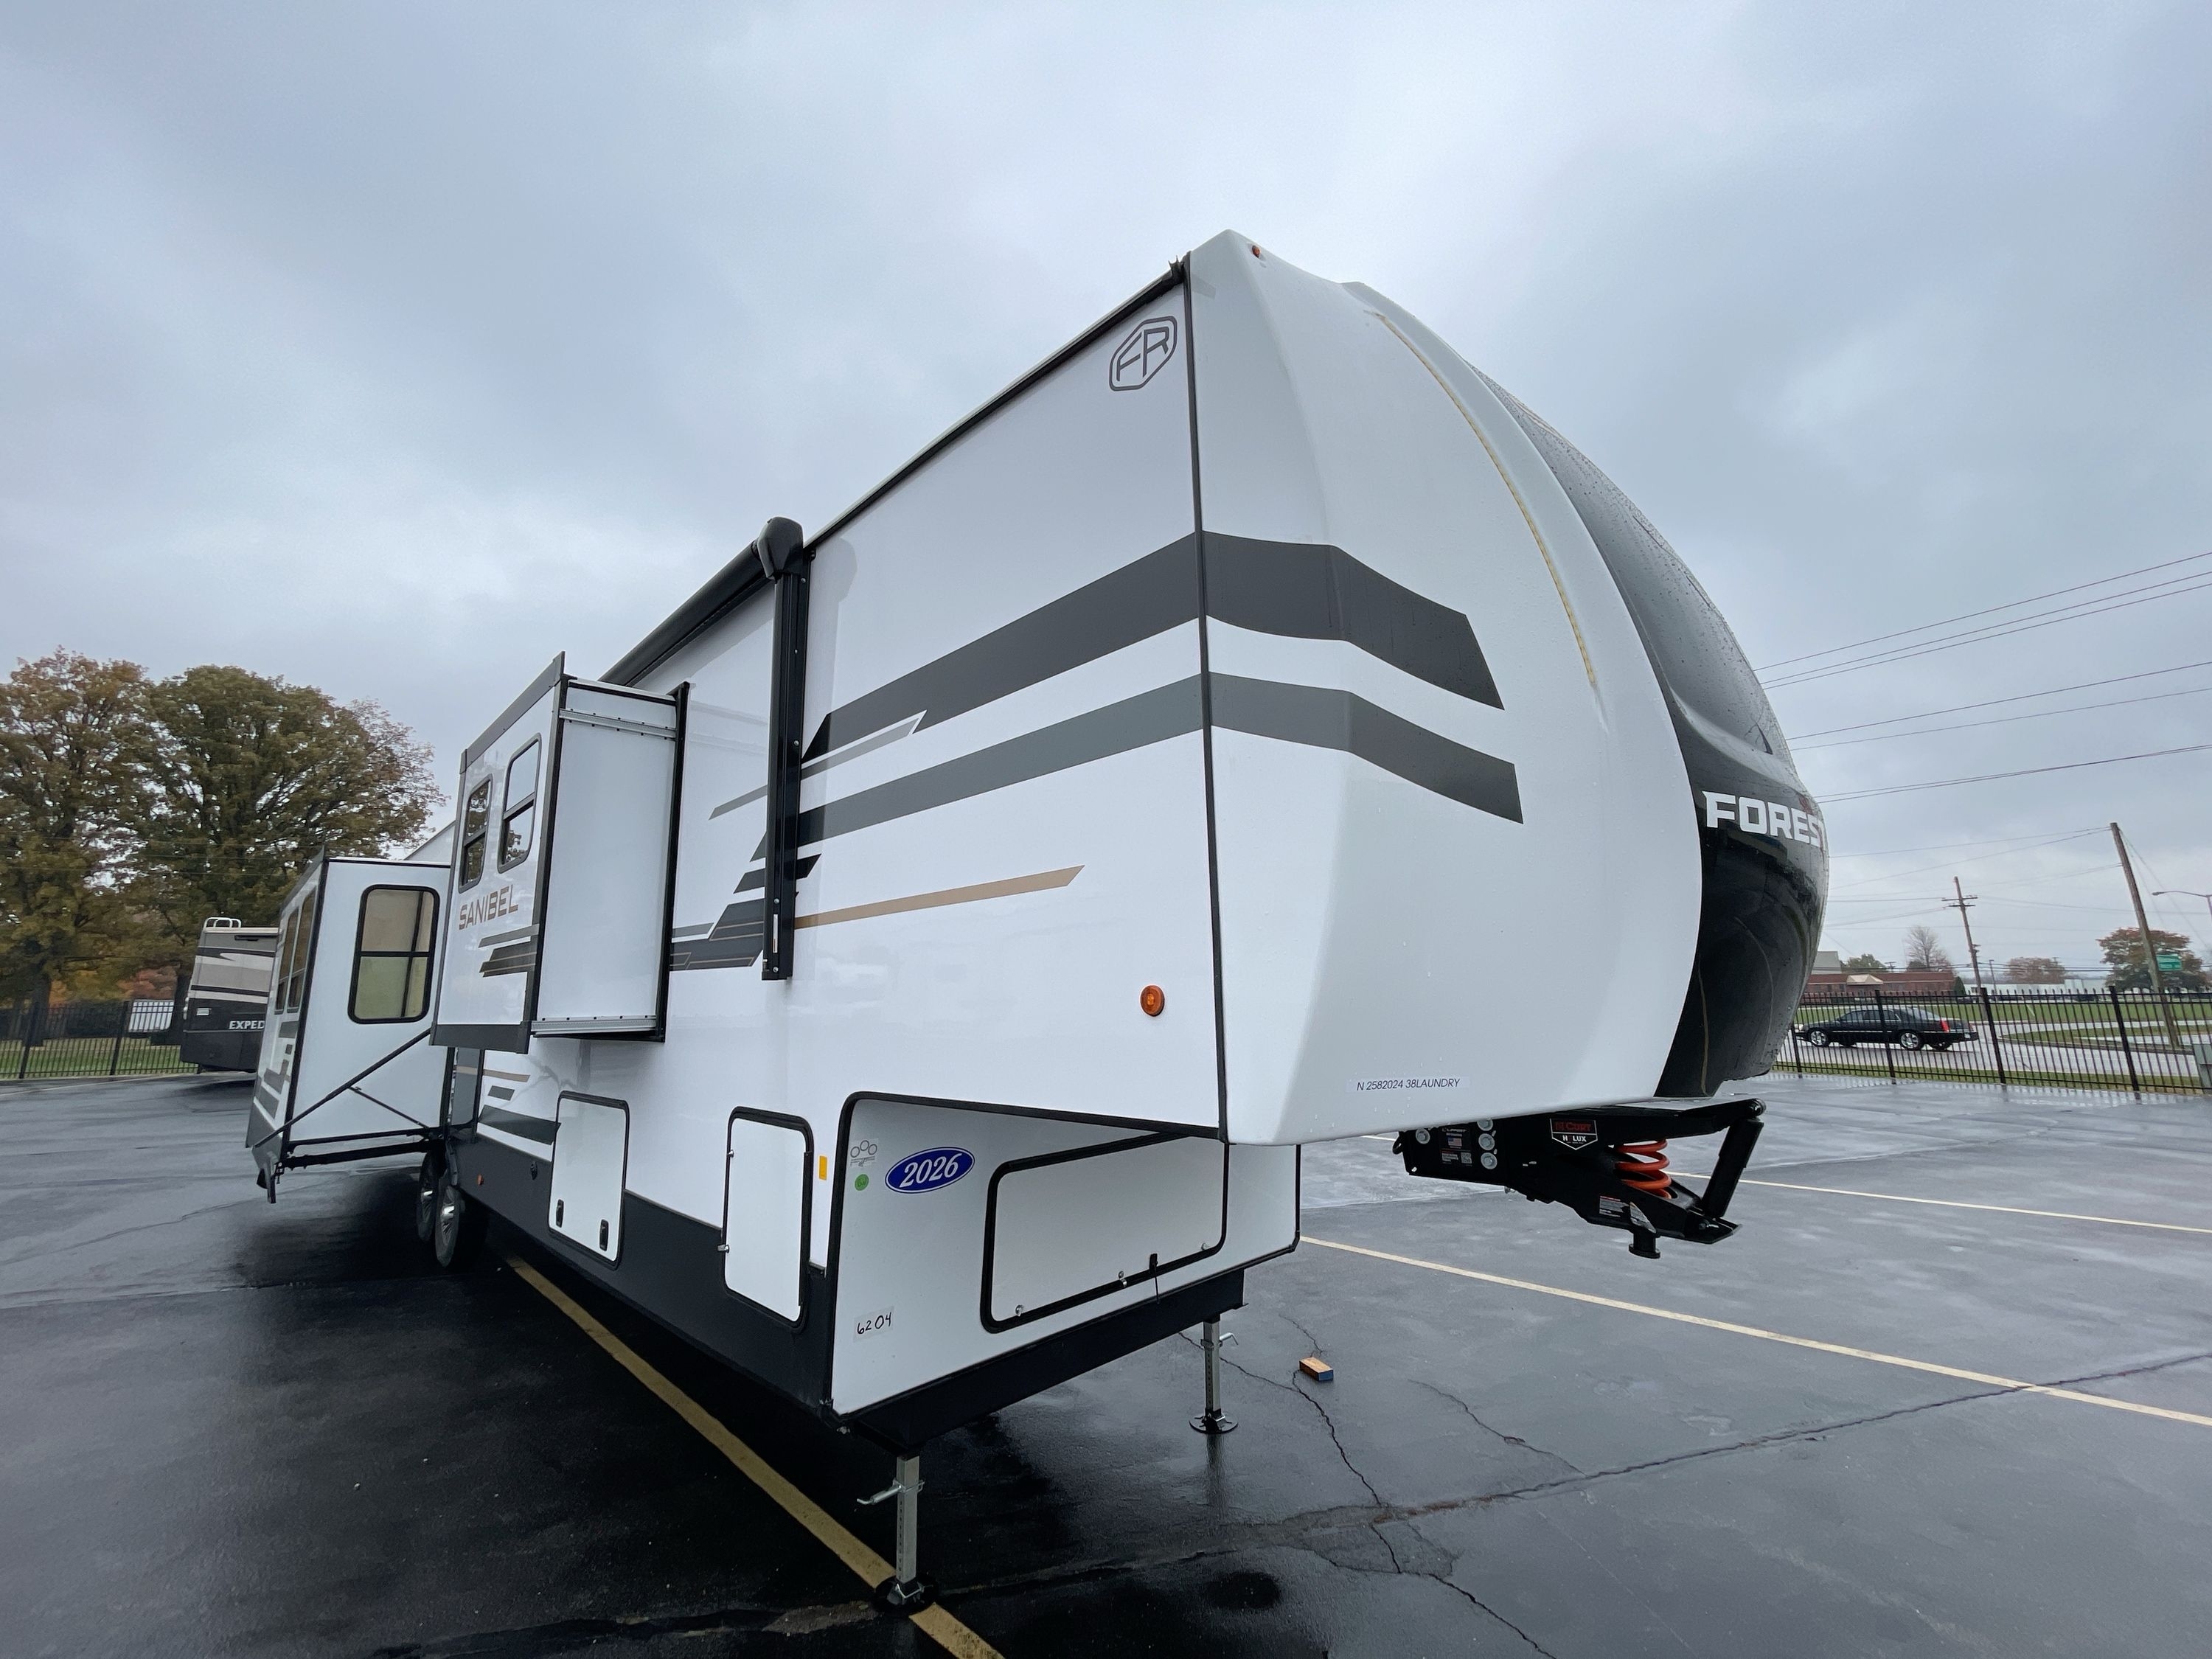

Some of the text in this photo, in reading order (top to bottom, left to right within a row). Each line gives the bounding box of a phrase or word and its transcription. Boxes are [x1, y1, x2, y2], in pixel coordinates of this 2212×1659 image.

[459, 884, 519, 931] SANIBEL
[229, 1020, 265, 1029] EXPED
[1356, 1078, 1461, 1091] N 2582024 38LAUNDRY
[899, 1152, 963, 1189] 2026
[857, 1311, 892, 1335] 6204
